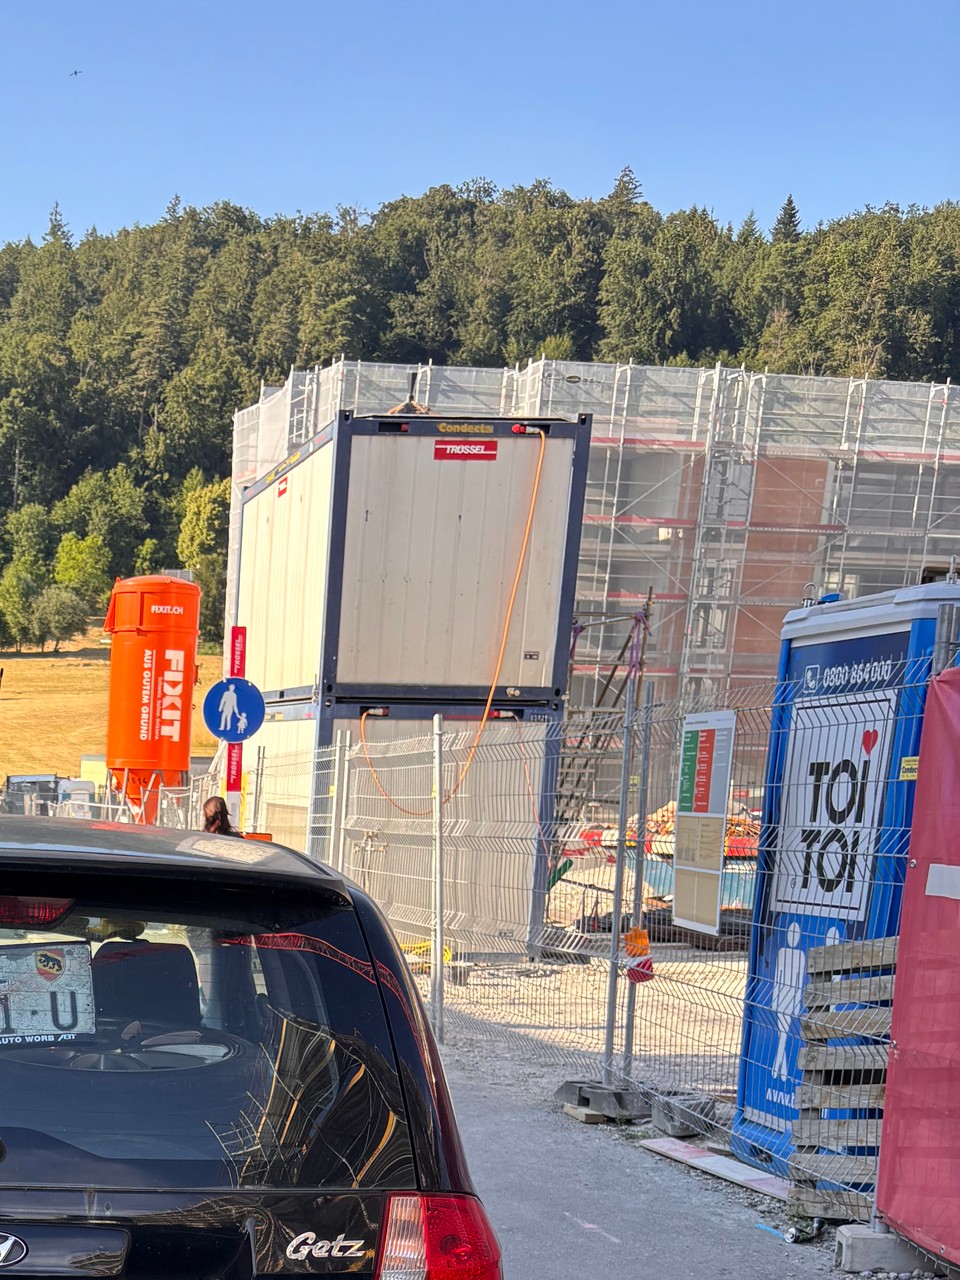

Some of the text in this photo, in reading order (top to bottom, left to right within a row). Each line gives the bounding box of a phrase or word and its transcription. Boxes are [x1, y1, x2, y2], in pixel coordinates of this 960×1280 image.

[437, 422, 494, 434] Condecta
[150, 604, 184, 615] FIXIT.CH
[139, 648, 152, 741] AUS GUTEM GRUND
[160, 648, 185, 743] FIXIT
[808, 758, 871, 825] TOI
[800, 828, 860, 893] TOI
[24, 1034, 55, 1043] WORB
[286, 1231, 365, 1261] Getz
